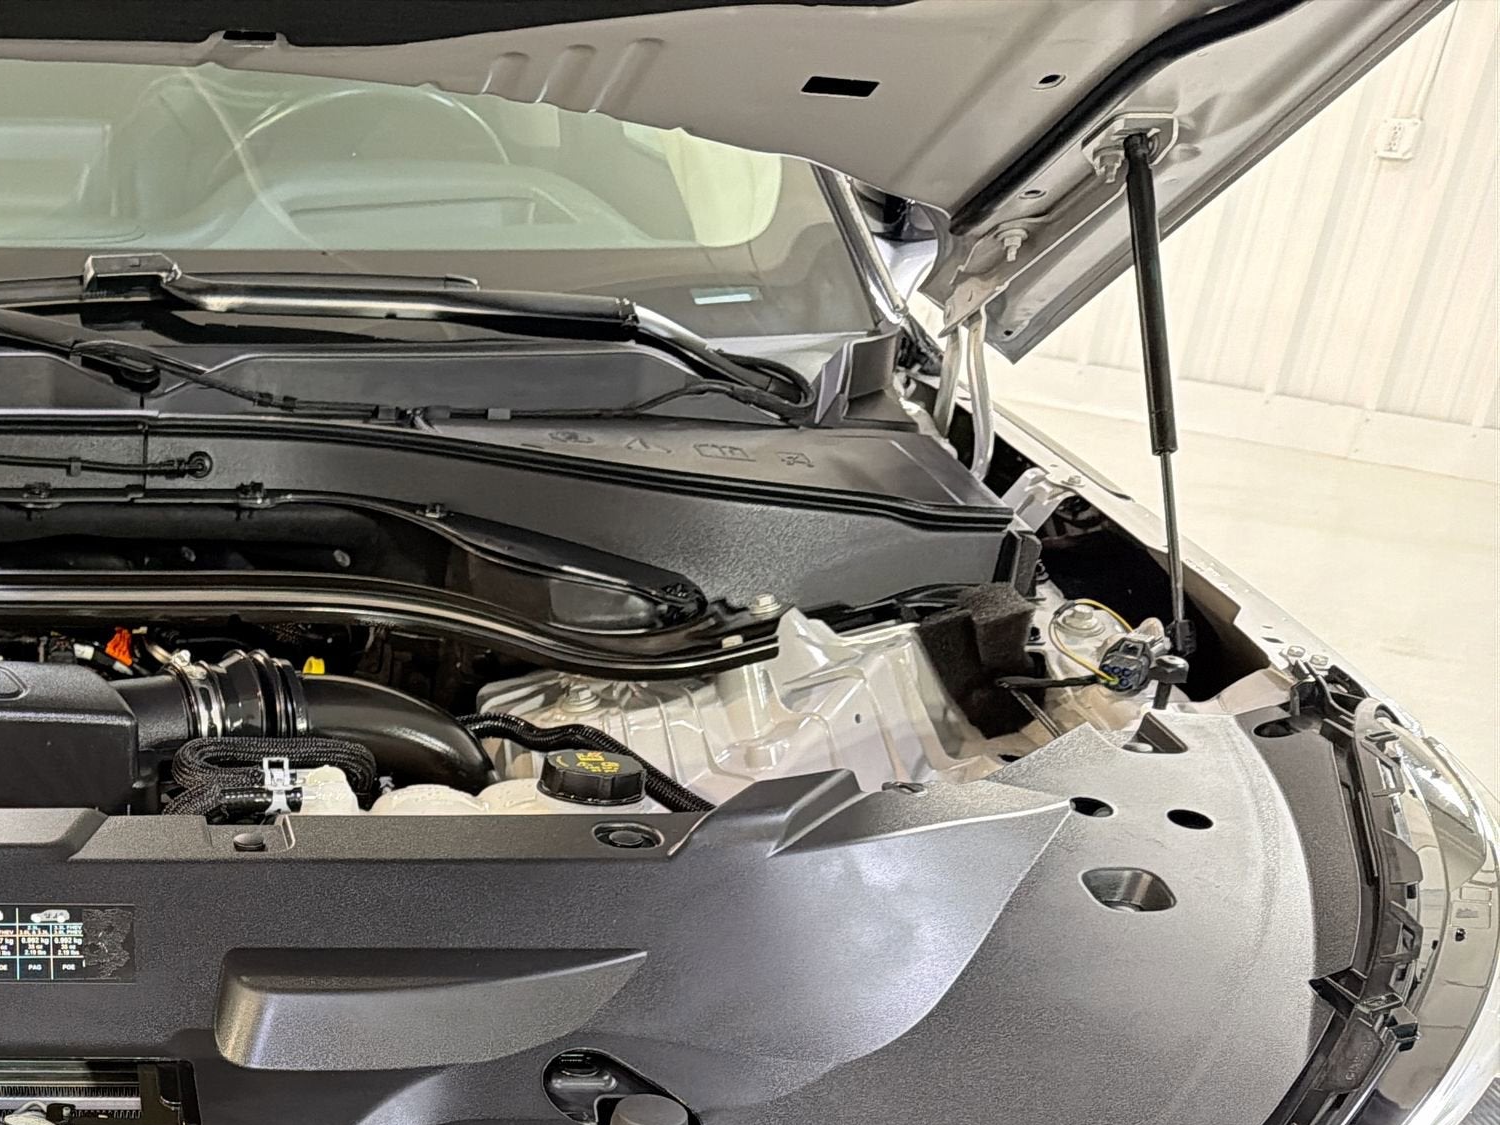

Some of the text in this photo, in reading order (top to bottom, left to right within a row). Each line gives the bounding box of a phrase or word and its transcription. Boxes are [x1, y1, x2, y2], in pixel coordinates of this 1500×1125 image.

[5, 938, 14, 946] kg
[40, 937, 50, 945] kg
[73, 937, 83, 945] kg
